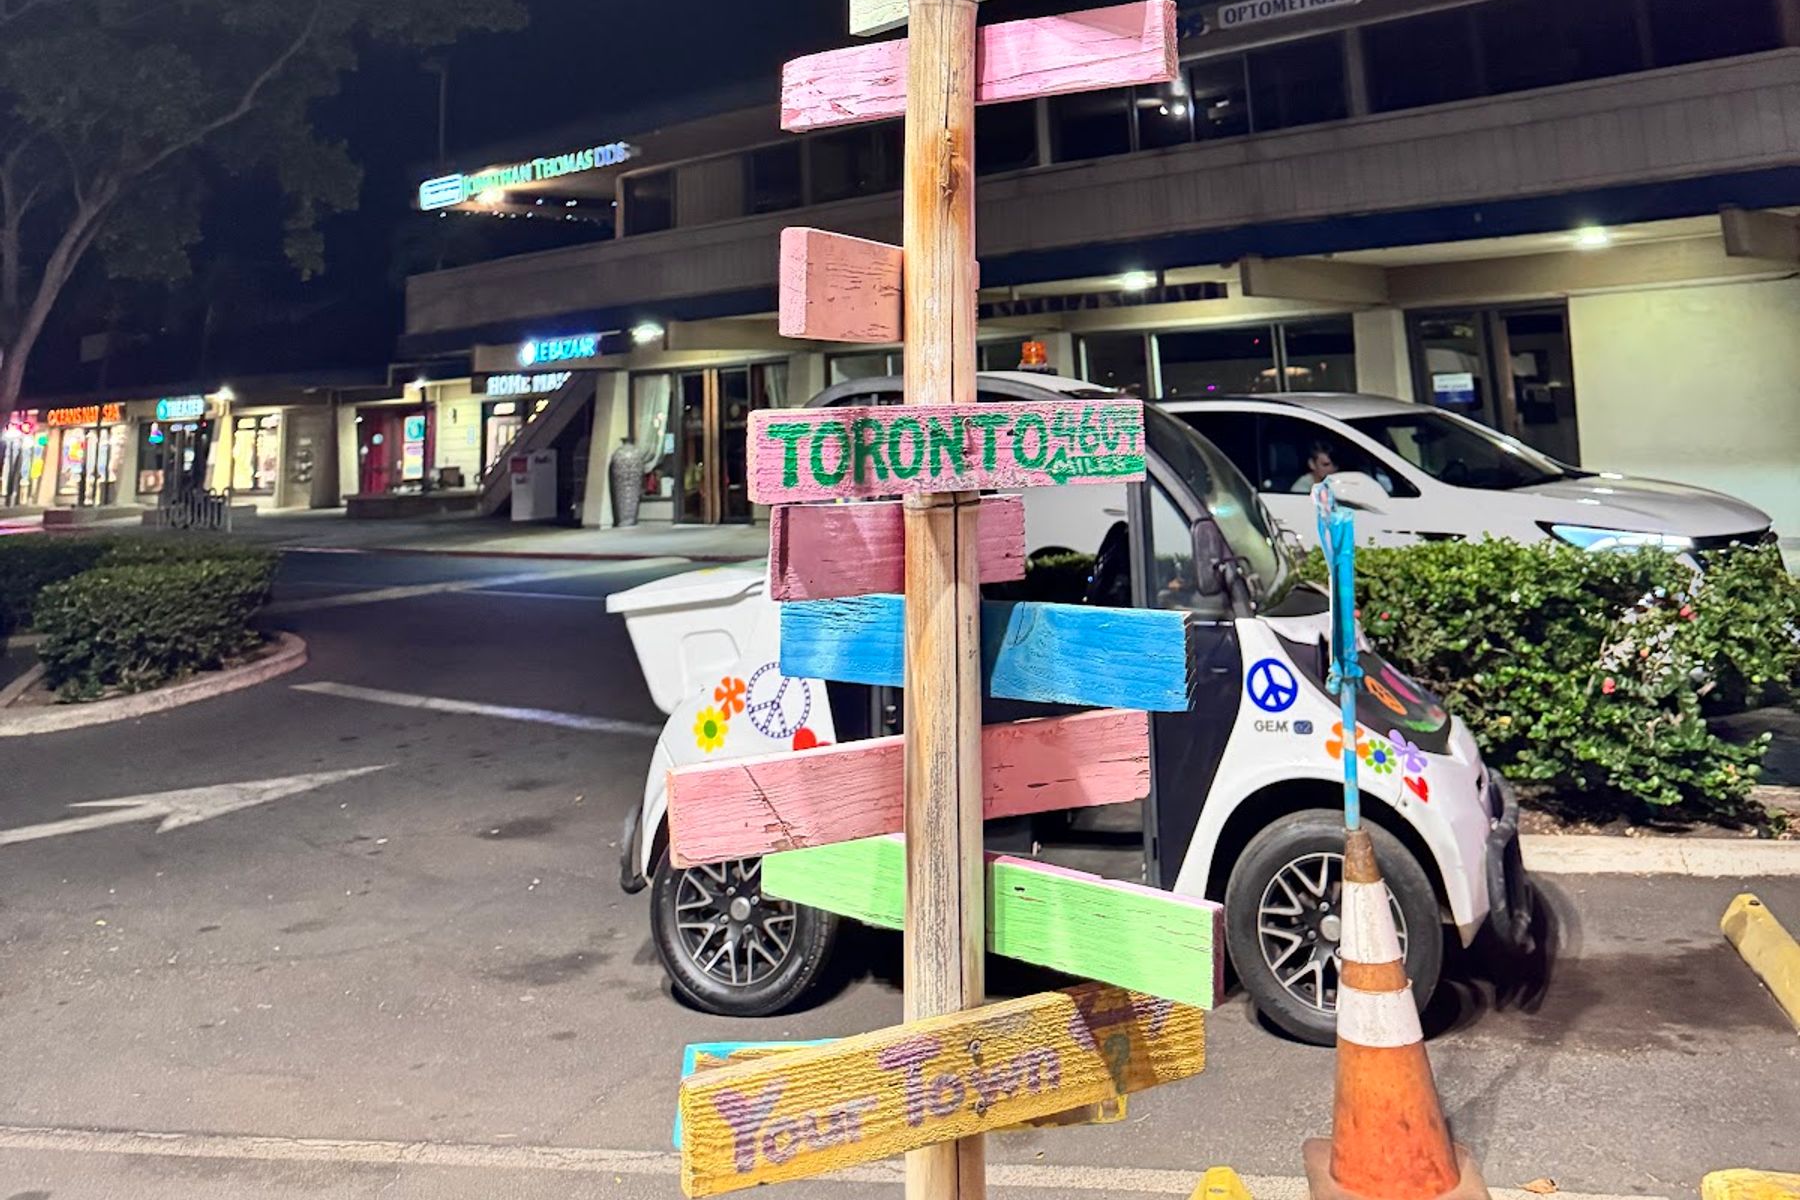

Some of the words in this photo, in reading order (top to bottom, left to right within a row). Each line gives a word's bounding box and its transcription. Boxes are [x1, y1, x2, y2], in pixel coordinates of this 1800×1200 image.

[532, 149, 593, 180] THOMAS
[594, 142, 628, 168] DDS
[549, 337, 595, 360] BAZAAR
[487, 374, 531, 395] HOME
[767, 412, 1049, 489] TORONTO
[1254, 719, 1289, 732] GEM
[711, 1076, 878, 1173] Your
[877, 1035, 1060, 1127] Town
